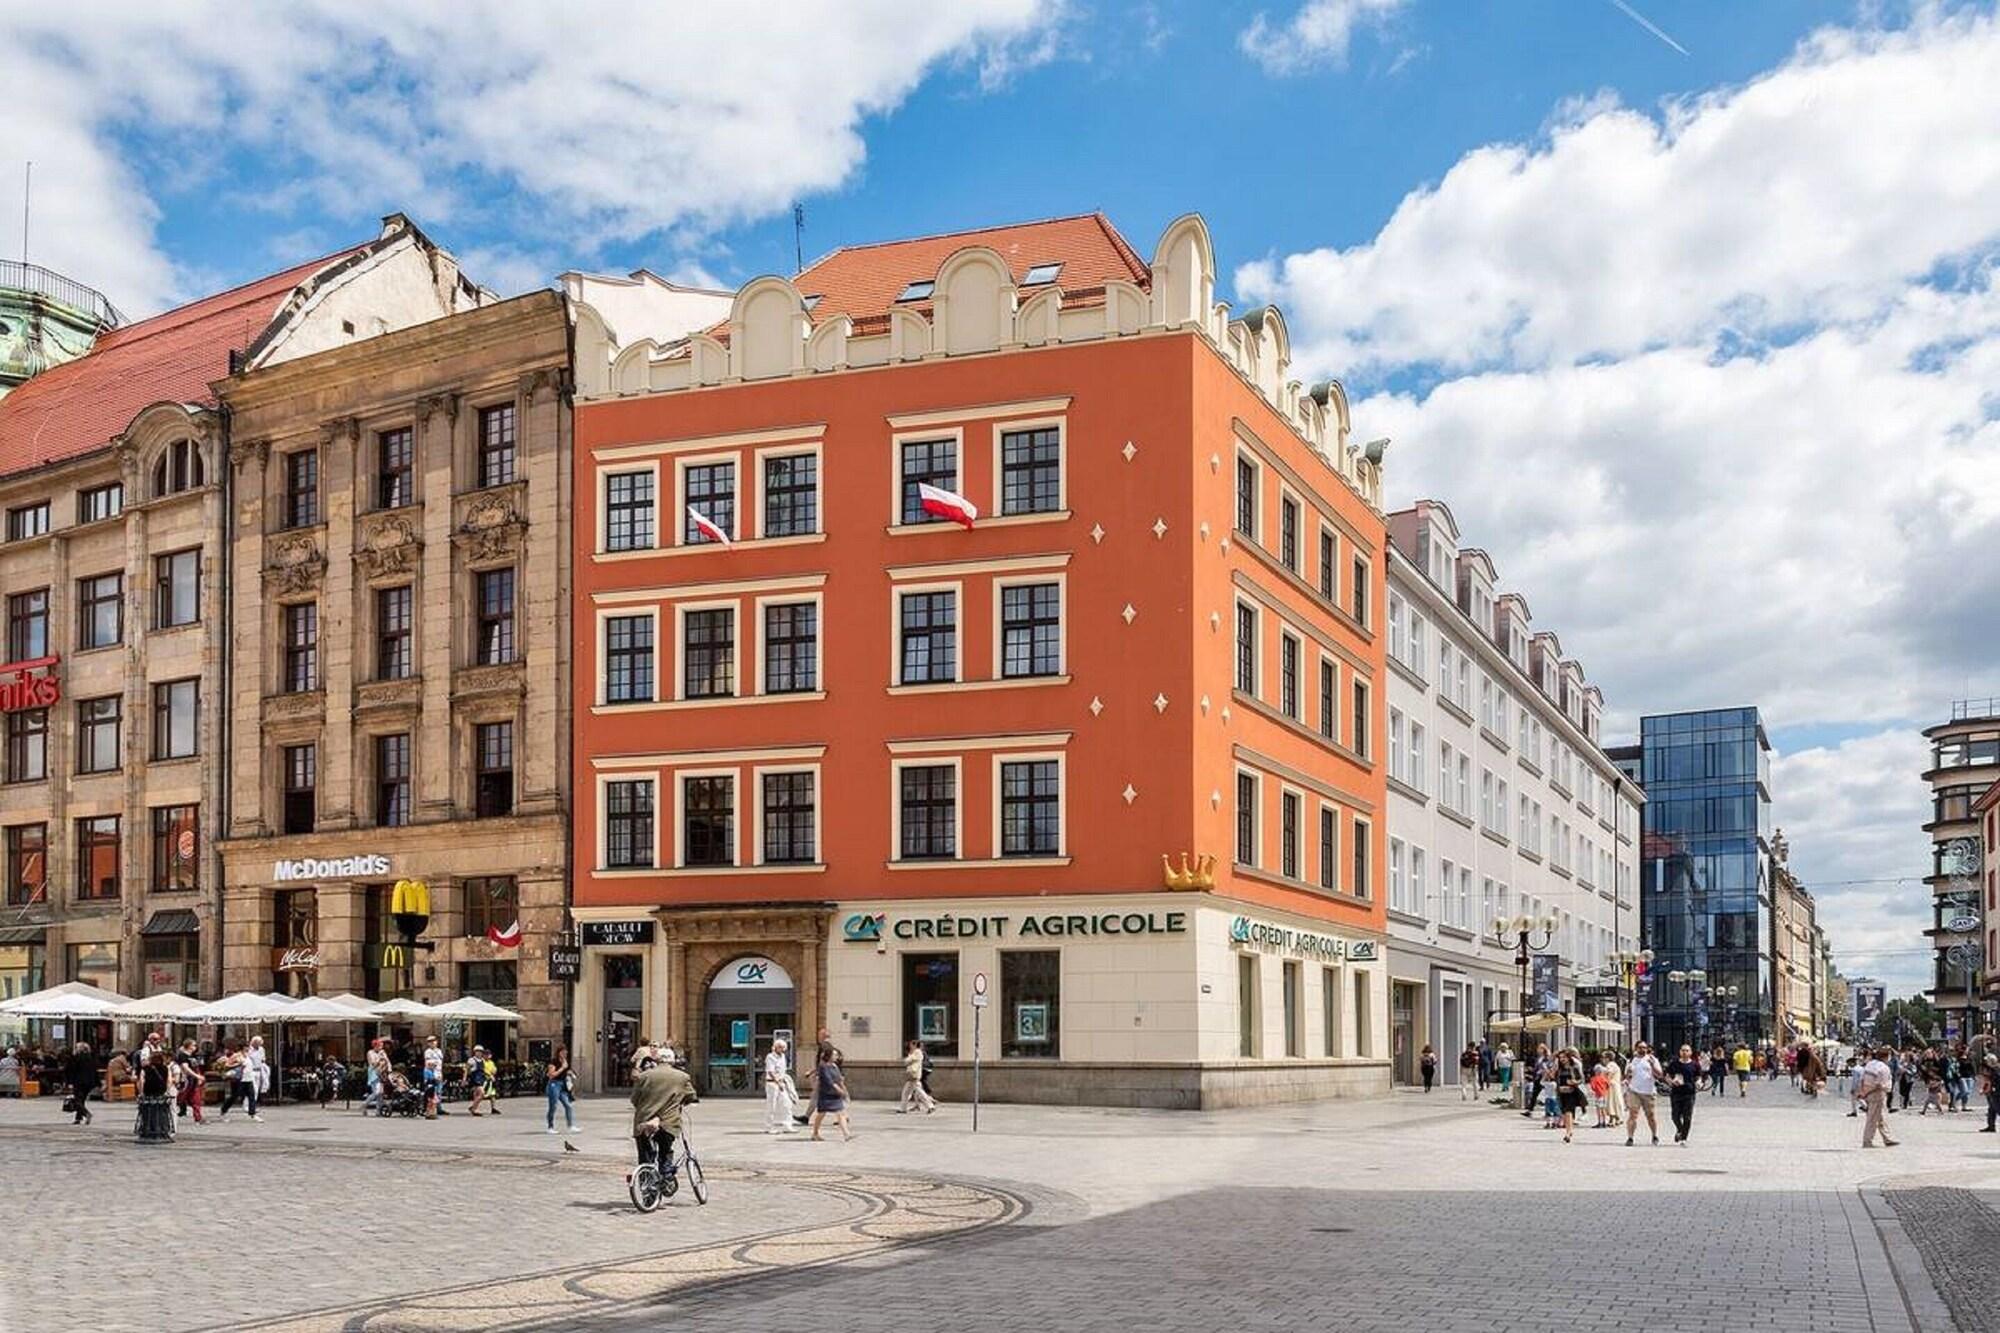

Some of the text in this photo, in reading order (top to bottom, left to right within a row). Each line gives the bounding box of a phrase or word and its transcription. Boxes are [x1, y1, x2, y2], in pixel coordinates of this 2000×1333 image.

[273, 854, 390, 880] McDonald's
[893, 914, 1009, 940] CRÉDIT
[1018, 912, 1187, 936] AGRICOLE
[1251, 923, 1292, 947] CRÉDIT
[1296, 932, 1343, 957] AGRICOLE
